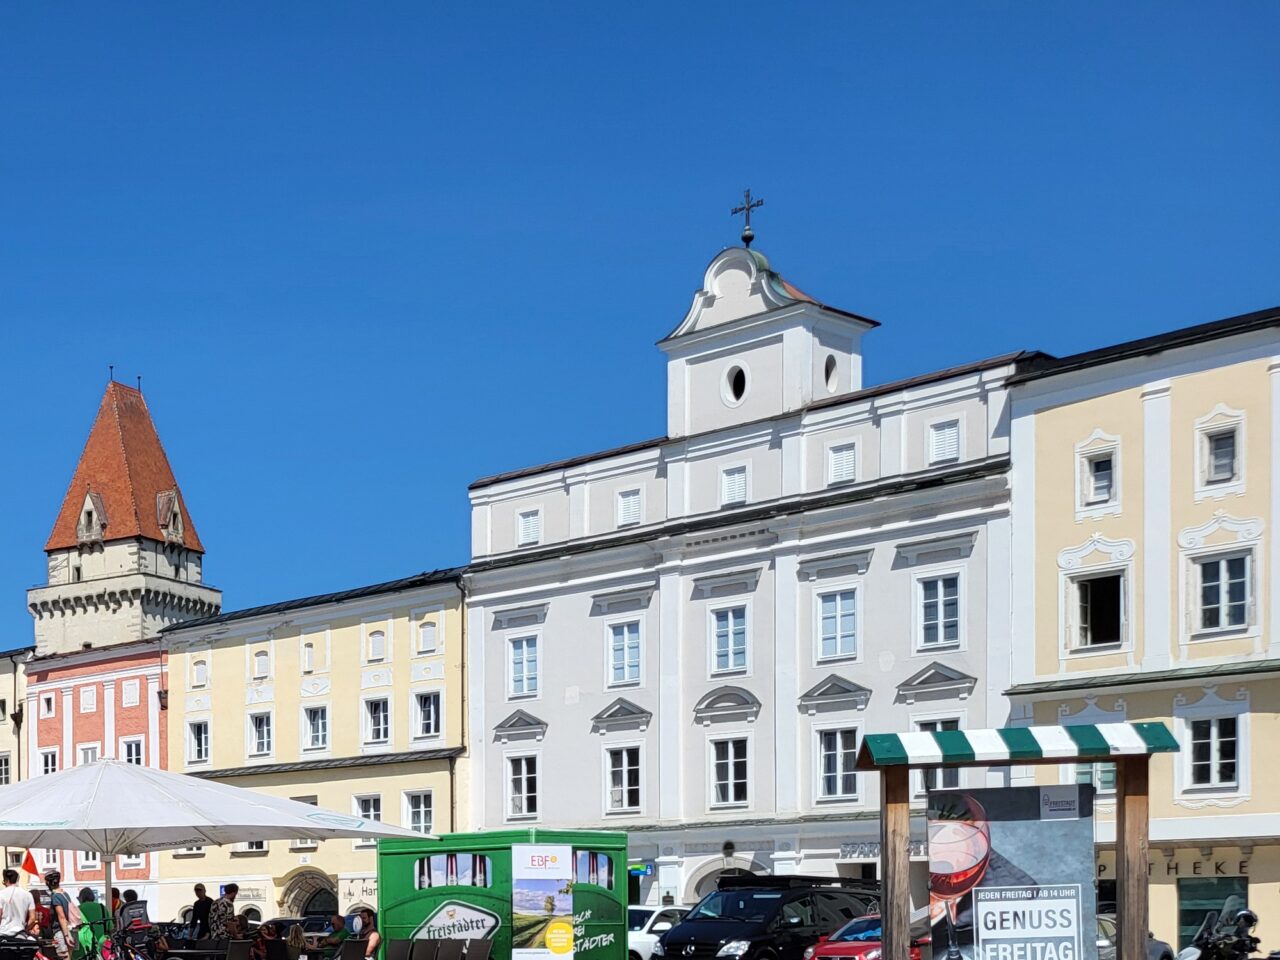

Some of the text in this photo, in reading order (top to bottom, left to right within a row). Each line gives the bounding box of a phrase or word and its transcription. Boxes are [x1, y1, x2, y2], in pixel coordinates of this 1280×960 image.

[361, 886, 378, 897] Har
[977, 891, 1000, 900] JEDEN
[1002, 890, 1032, 899] FREITAG
[1038, 890, 1049, 898] AB
[1050, 889, 1058, 898] 14
[1059, 889, 1076, 897] UHR
[983, 908, 1073, 931] GENUSS
